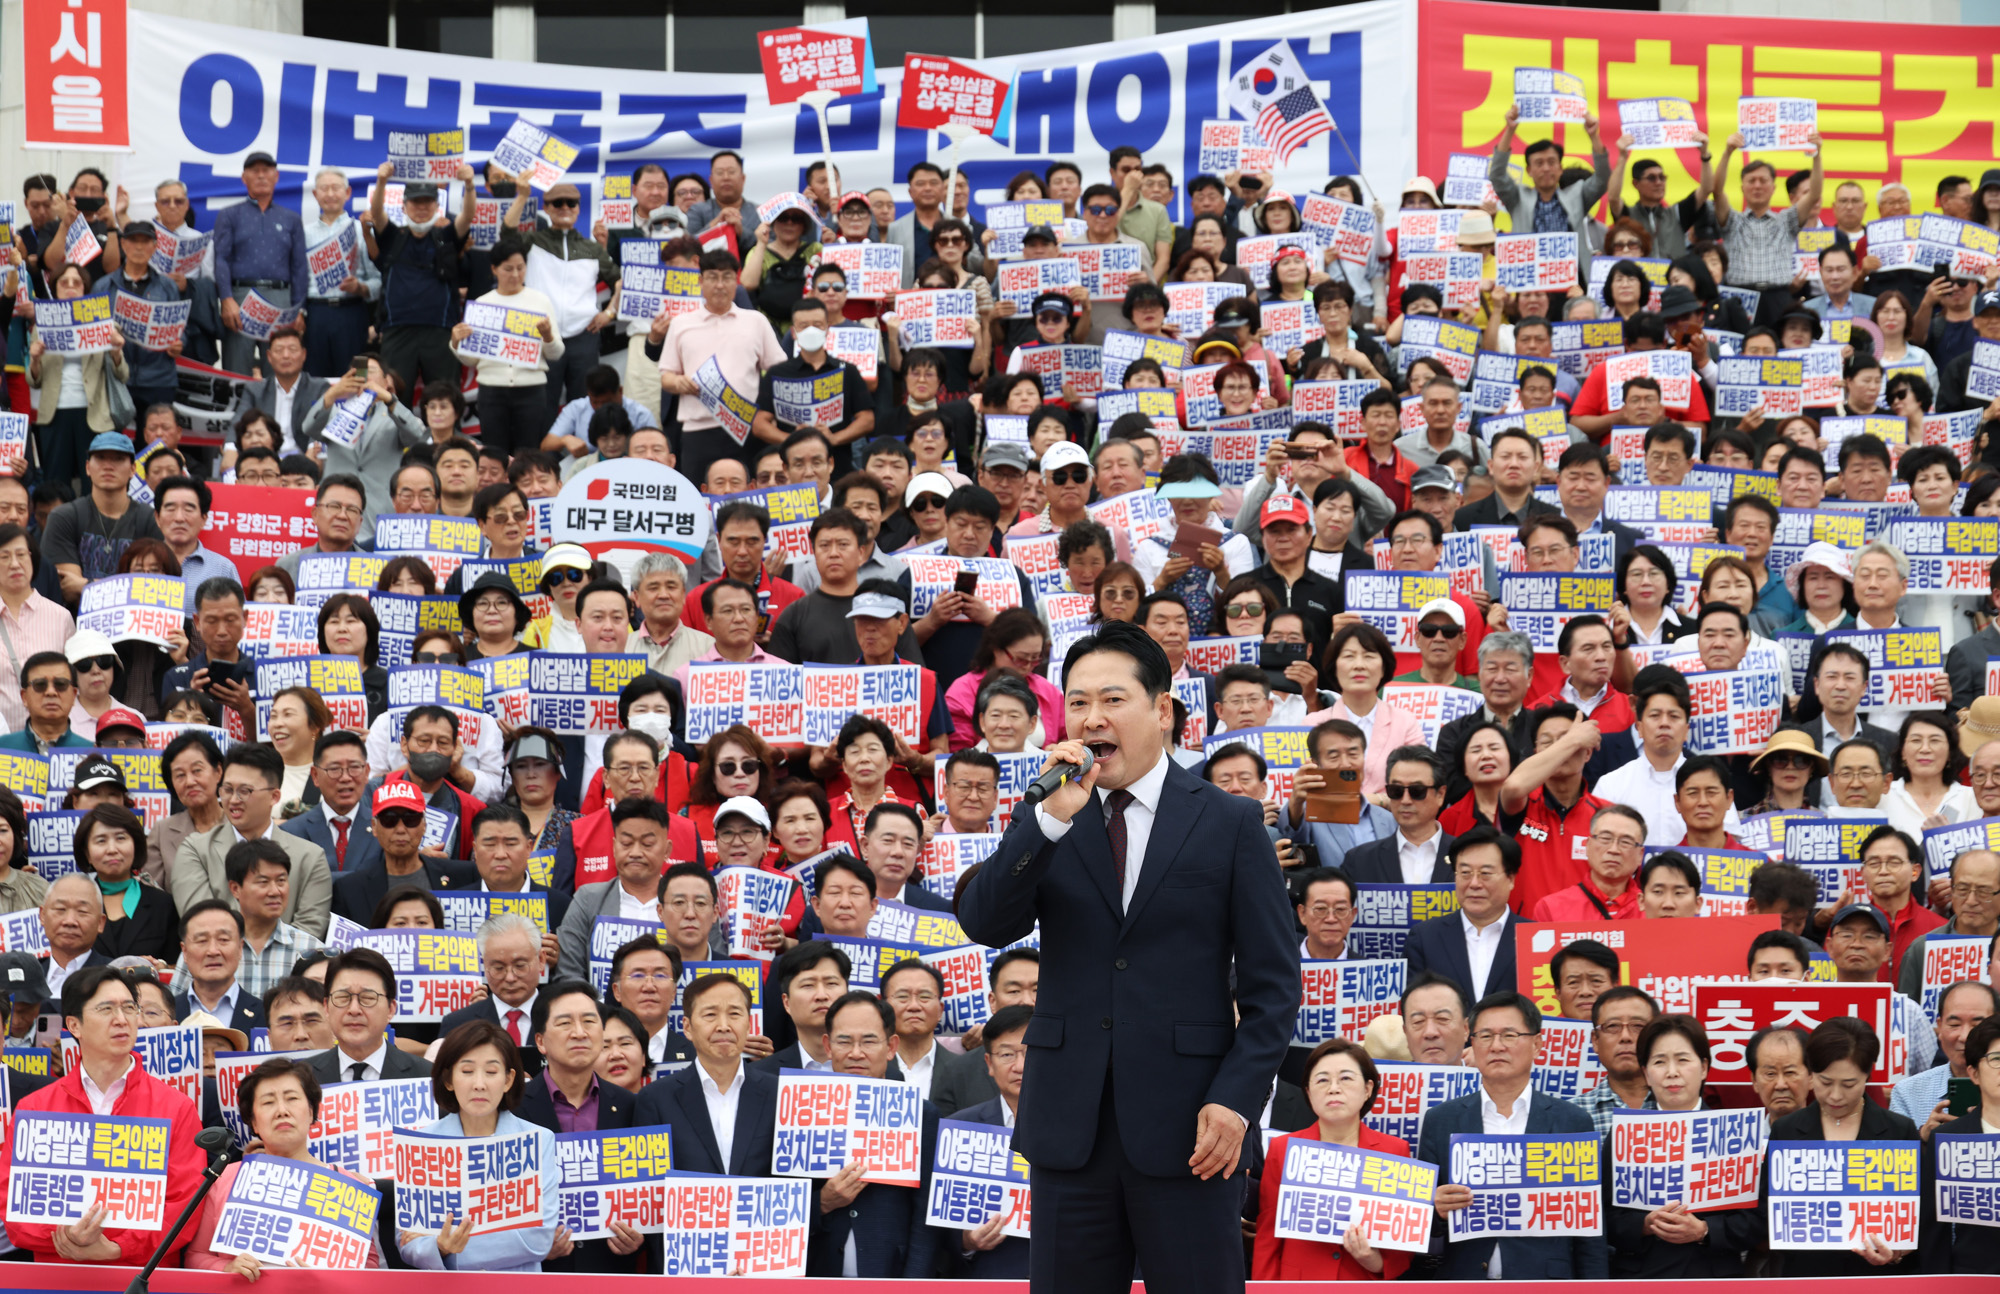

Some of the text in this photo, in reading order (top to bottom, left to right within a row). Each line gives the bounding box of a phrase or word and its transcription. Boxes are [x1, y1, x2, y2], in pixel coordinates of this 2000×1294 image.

[50, 0, 103, 132] 시을
[776, 38, 853, 63] 보수의심장
[779, 55, 857, 83] 상주문경
[918, 72, 996, 95] 보수의심장
[1515, 68, 1553, 94] 야당말살
[916, 90, 994, 116] 상주문경
[1619, 99, 1694, 121] 야당말살 특검악법
[1740, 101, 1816, 124] 야당탄압 독재정치
[389, 129, 464, 154] 야당말살 특검악법
[1203, 125, 1240, 146] 야당탄압
[1202, 149, 1239, 170] 정치보복
[1798, 231, 1836, 253] 특검악법
[1868, 217, 1905, 242] 야당말살
[1921, 215, 1999, 255] 야당말살 특검악법
[864, 247, 901, 268] 독재정치
[1103, 248, 1140, 268] 독재정치
[1498, 235, 1578, 264] 야당탄압 독재정치
[622, 266, 664, 292] 야당말살
[863, 271, 902, 292] 규탄한다
[1001, 261, 1079, 290] 야당탄압 독재정치
[1410, 257, 1481, 279] 야당탄압 독재정치
[1498, 260, 1577, 289] 정치보복 규탄한다
[35, 293, 112, 327] 야당말살 특검악법
[115, 291, 191, 326] 야당탄압 독재정치
[1166, 287, 1203, 309] 야당탄압
[465, 304, 507, 330] 야당말살
[1262, 304, 1301, 331] 야당탄압
[1582, 321, 1623, 345] 특검악법
[501, 337, 541, 364] 거부하라
[838, 330, 877, 351] 독재정치
[1103, 331, 1186, 367] 야당말살 특검악법
[1401, 316, 1480, 355] 야당말살 특검악법
[1063, 348, 1101, 371] 독재정치
[1479, 354, 1518, 381] 야당말살
[1608, 353, 1690, 382] 야당탄압 독재정치
[1719, 360, 1802, 384] 야당말살 특검악법
[773, 370, 844, 404] 야당말살 특검악법
[1294, 382, 1337, 412] 야당탄압
[1717, 388, 1801, 413] 대통령은 거부하라
[1803, 376, 1842, 401] 규탄한다
[1098, 391, 1177, 419] 야당말살 특검악법
[1523, 407, 1567, 436] 특검악법
[1213, 438, 1257, 460] 야당탄압
[613, 482, 677, 501] 국민의힘
[766, 488, 818, 523] 특검악법
[1605, 489, 1712, 520] 야당말살 특검악법
[376, 520, 482, 553] 야당말살 특검악법
[567, 507, 695, 535] 대구 달서구병
[1813, 514, 1866, 547] 특검악법
[1891, 521, 1999, 553] 야당말살 특검악법
[299, 558, 347, 589] 야당말살
[911, 560, 961, 583] 야당탄압
[81, 575, 187, 613] 야당말살 특검악법
[1346, 576, 1401, 608] 야당말살
[1502, 577, 1614, 609] 야당말살 특검악법
[370, 595, 418, 632] 야당말살
[1886, 633, 1942, 668] 특검악법
[257, 660, 364, 698] 야당말살 특검악법
[388, 668, 484, 709] 야당말살 특검악법
[530, 658, 589, 692] 야당말살
[690, 668, 803, 705] 야당탄압 독재정치
[805, 667, 918, 708] 야당탄압 독재정치
[1732, 670, 1781, 710] 독재정치
[530, 698, 586, 730] 대통령은
[748, 703, 803, 738] 규탄한다
[1733, 707, 1781, 748] 규탄한다
[377, 782, 415, 803] MAGA
[1784, 825, 1840, 862] 야당말살
[417, 934, 479, 974] 특검악법
[1926, 943, 1984, 985] 야당탄압
[1341, 961, 1405, 1003] 독재정치
[363, 1079, 436, 1128] 독재정치
[778, 1083, 921, 1129] 야당탄압 독재정치
[14, 1117, 169, 1171] 야당말살 특검악법
[775, 1128, 919, 1173] 정치보복 규탄한다
[938, 1126, 1011, 1178] 야당말살
[1615, 1111, 1761, 1165] 야당탄압 독재정치
[395, 1131, 540, 1188] 야당탄압 독재정치
[602, 1132, 671, 1181] 특검악법
[1286, 1144, 1436, 1202] 야당말살 특검악법
[1451, 1139, 1599, 1186] 야당말살 특검악법
[1771, 1148, 1918, 1192] 야당말살 특검악법
[1614, 1153, 1760, 1206] 정치보복 규탄한다
[11, 1173, 163, 1223] 대통령은 거부하라
[231, 1159, 379, 1236] 야당말살 특검악법
[396, 1174, 541, 1230] 정치보복 규탄한다
[665, 1181, 808, 1230] 야당탄압 독재정치
[930, 1178, 1004, 1226] 대통령은
[1527, 1189, 1600, 1231] 거부하라
[1279, 1190, 1429, 1246] 대통령은 거부하라
[1773, 1200, 1843, 1243] 대통령은
[216, 1207, 366, 1269] 대통령은 거부하라
[665, 1226, 806, 1277] 정치보복 규탄한다
